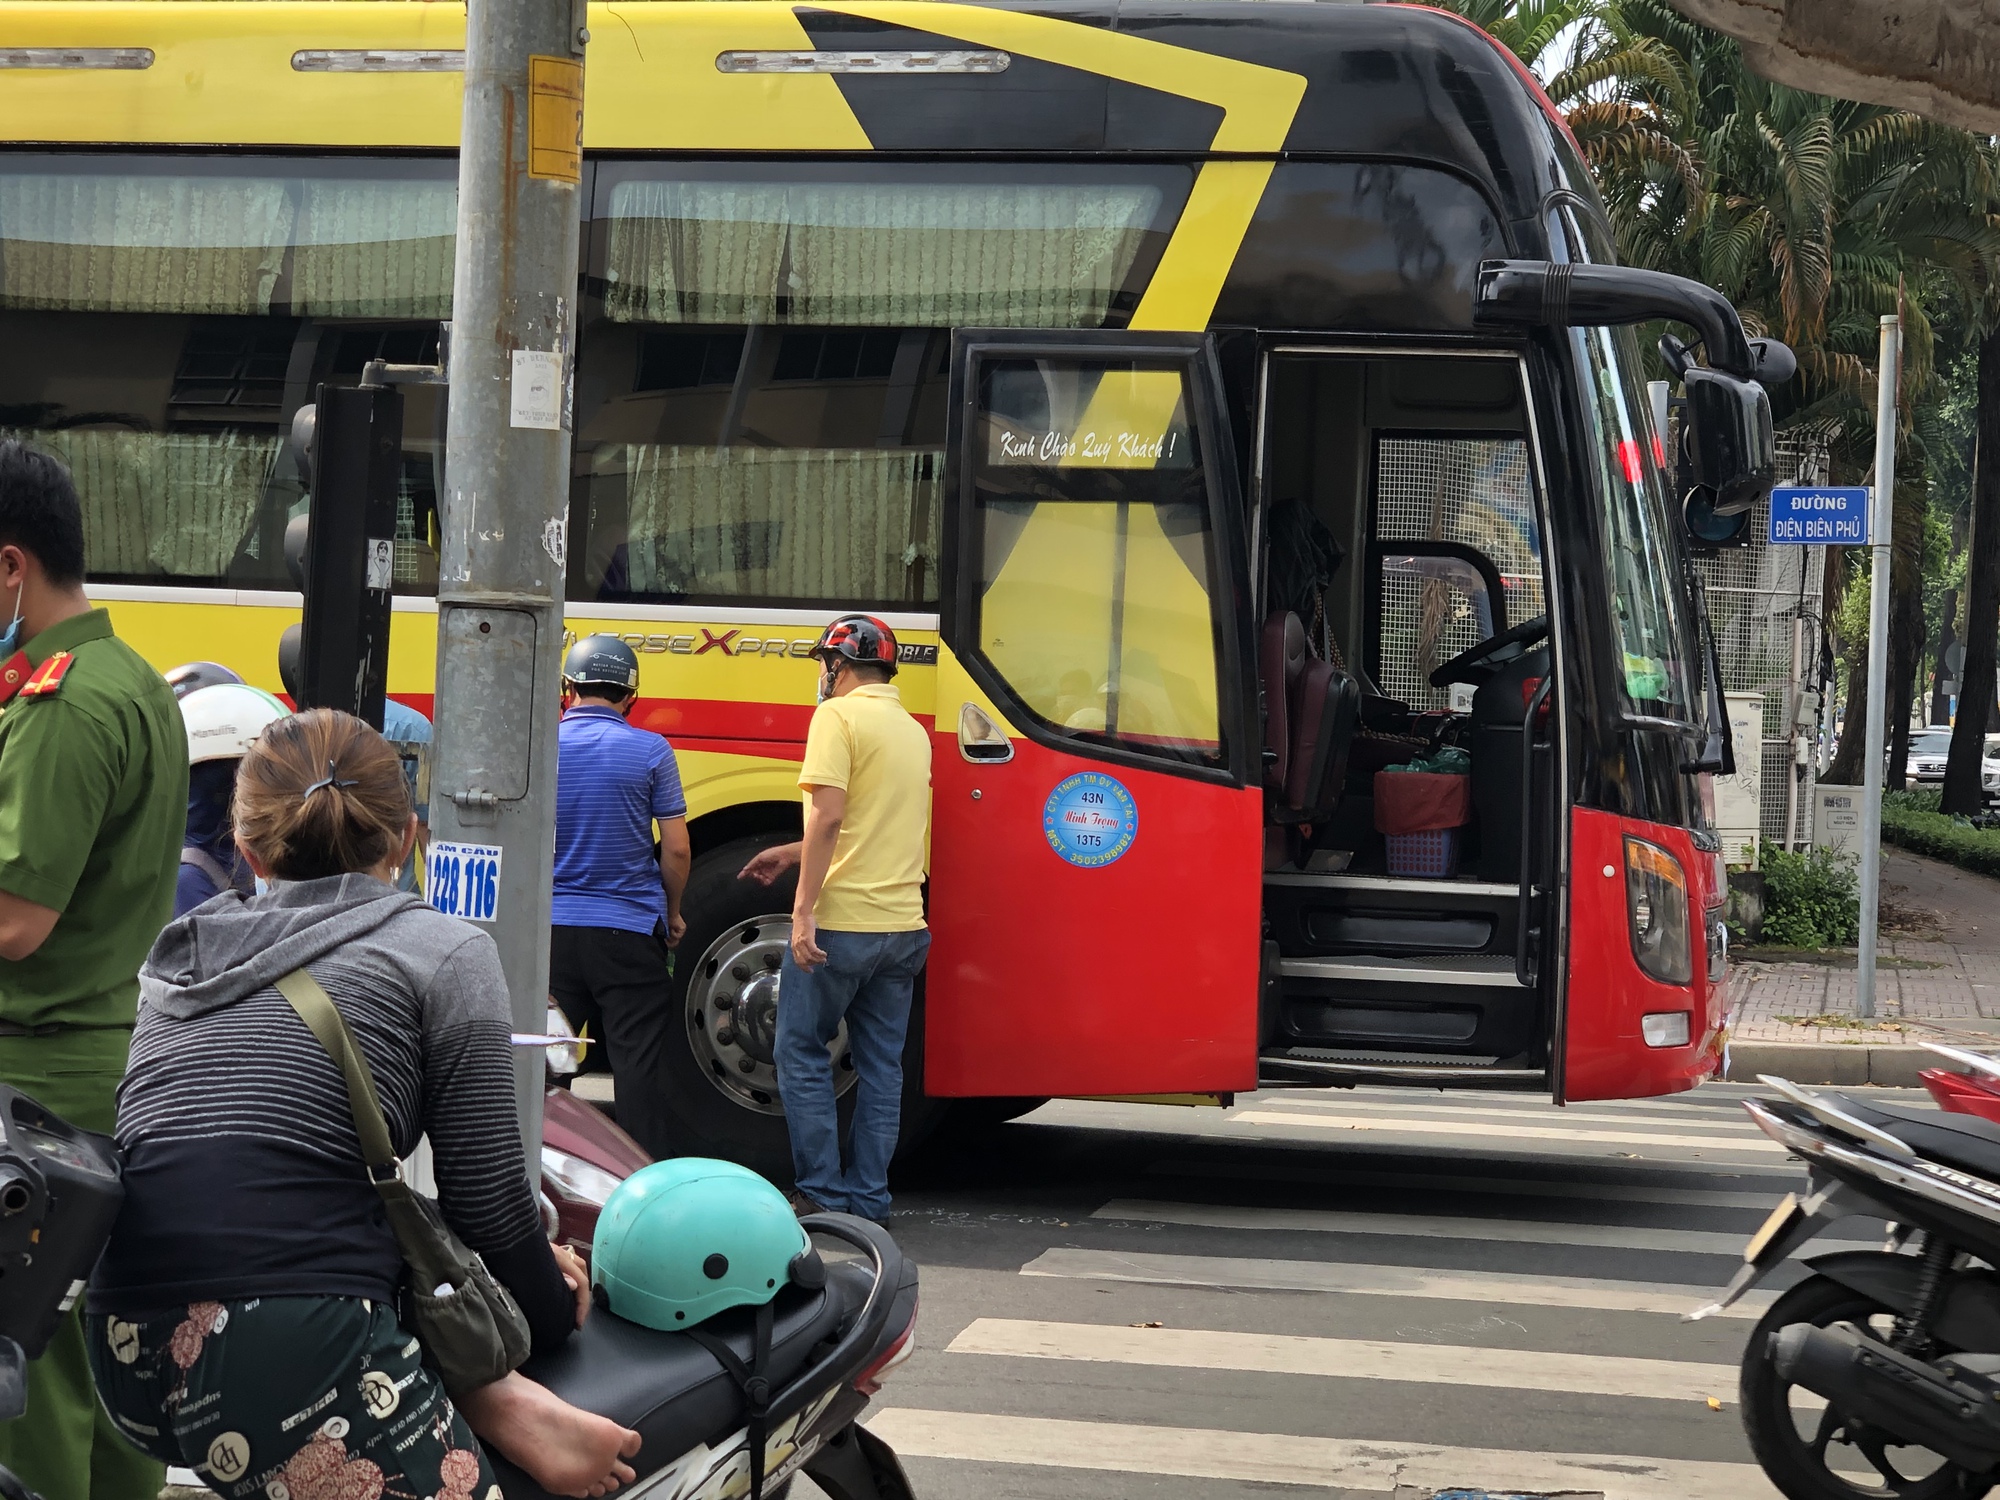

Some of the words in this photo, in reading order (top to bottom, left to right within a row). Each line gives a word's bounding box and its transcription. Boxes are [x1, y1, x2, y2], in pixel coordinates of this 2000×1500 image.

[1040, 431, 1076, 461] Chào
[1081, 431, 1113, 463] Quý
[1790, 494, 1847, 510] ĐƯỜNG
[1775, 517, 1802, 540] ĐIỆN
[1805, 517, 1833, 538] BIÊN
[1835, 515, 1860, 538] PHỦ
[1047, 795, 1059, 812] CTY
[1057, 777, 1081, 794] TNHH
[1084, 774, 1096, 783] TM
[1099, 777, 1112, 787] DV
[1081, 792, 1104, 804] 43N
[1064, 810, 1087, 823] Minh
[1076, 834, 1101, 846] 13T5
